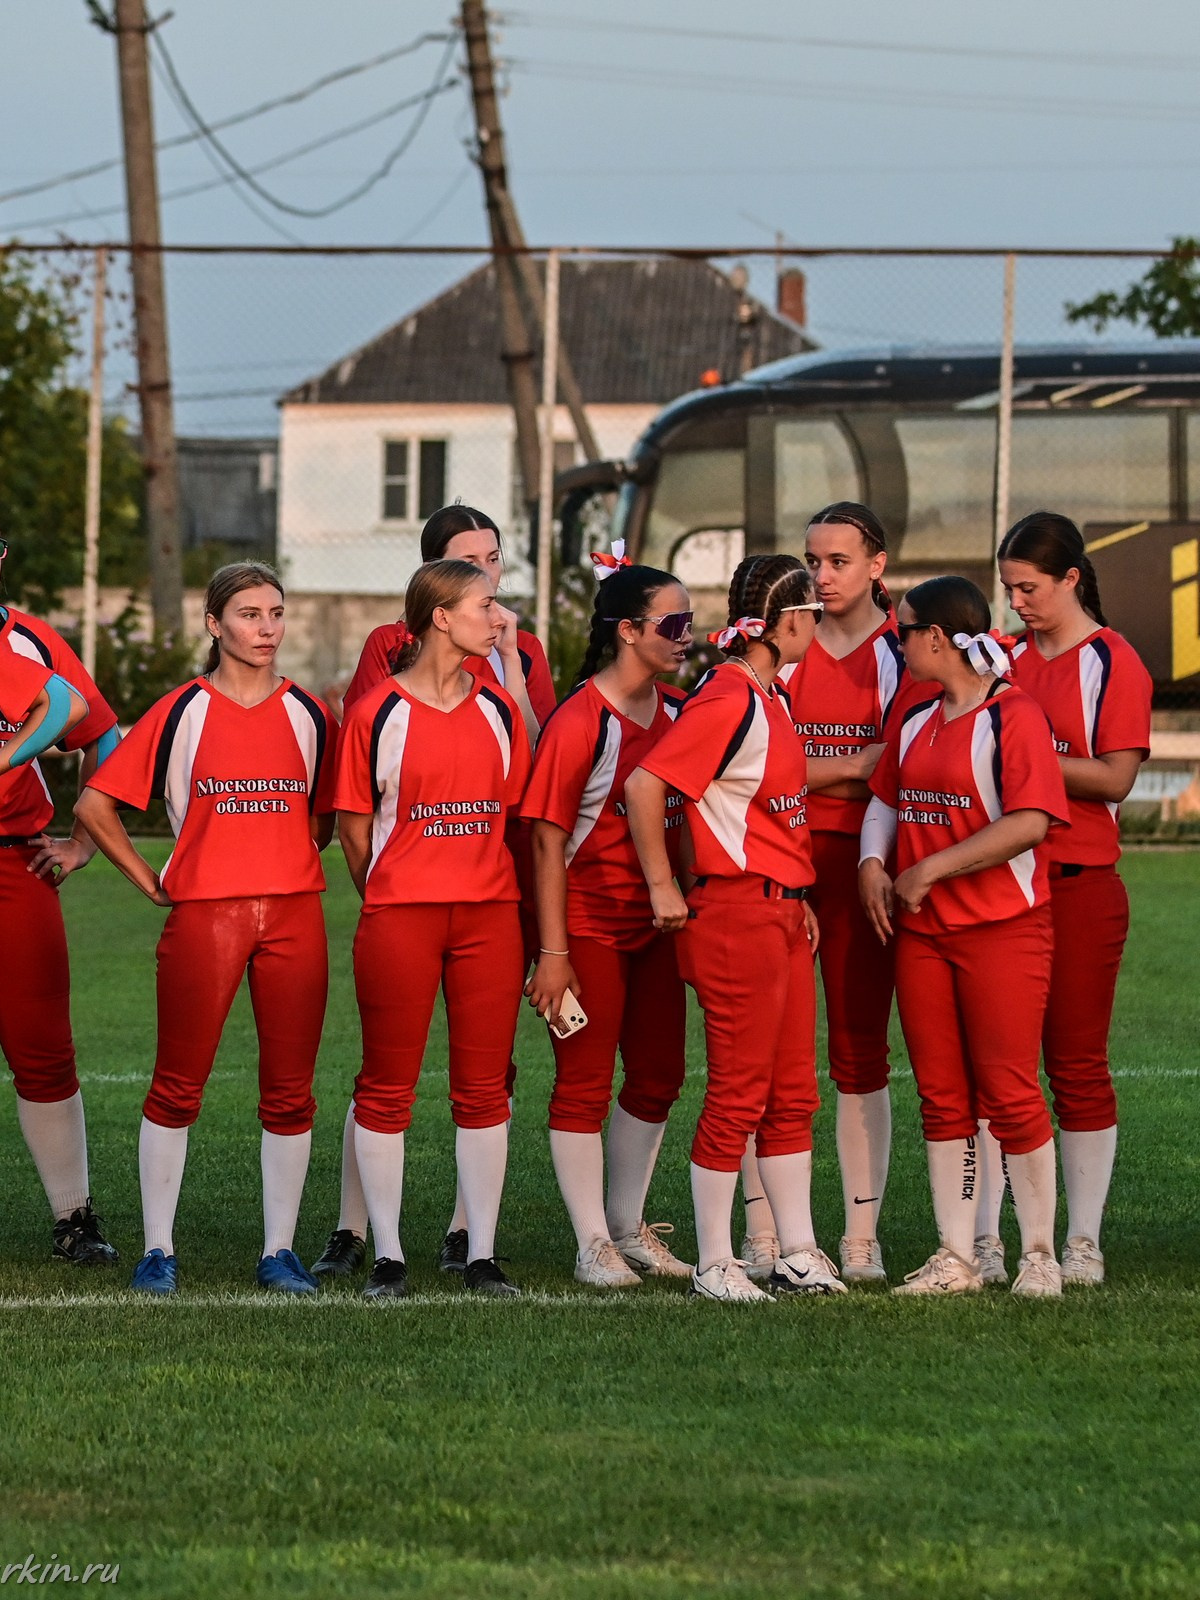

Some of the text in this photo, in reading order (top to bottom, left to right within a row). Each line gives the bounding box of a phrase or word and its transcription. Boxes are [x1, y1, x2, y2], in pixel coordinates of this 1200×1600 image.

[793, 723, 876, 738] осковска
[804, 739, 862, 757] бласт
[196, 777, 307, 798] Московская
[215, 796, 290, 814] область
[898, 788, 972, 809] осковская
[423, 819, 491, 837] область
[961, 1151, 976, 1201] PATRICK
